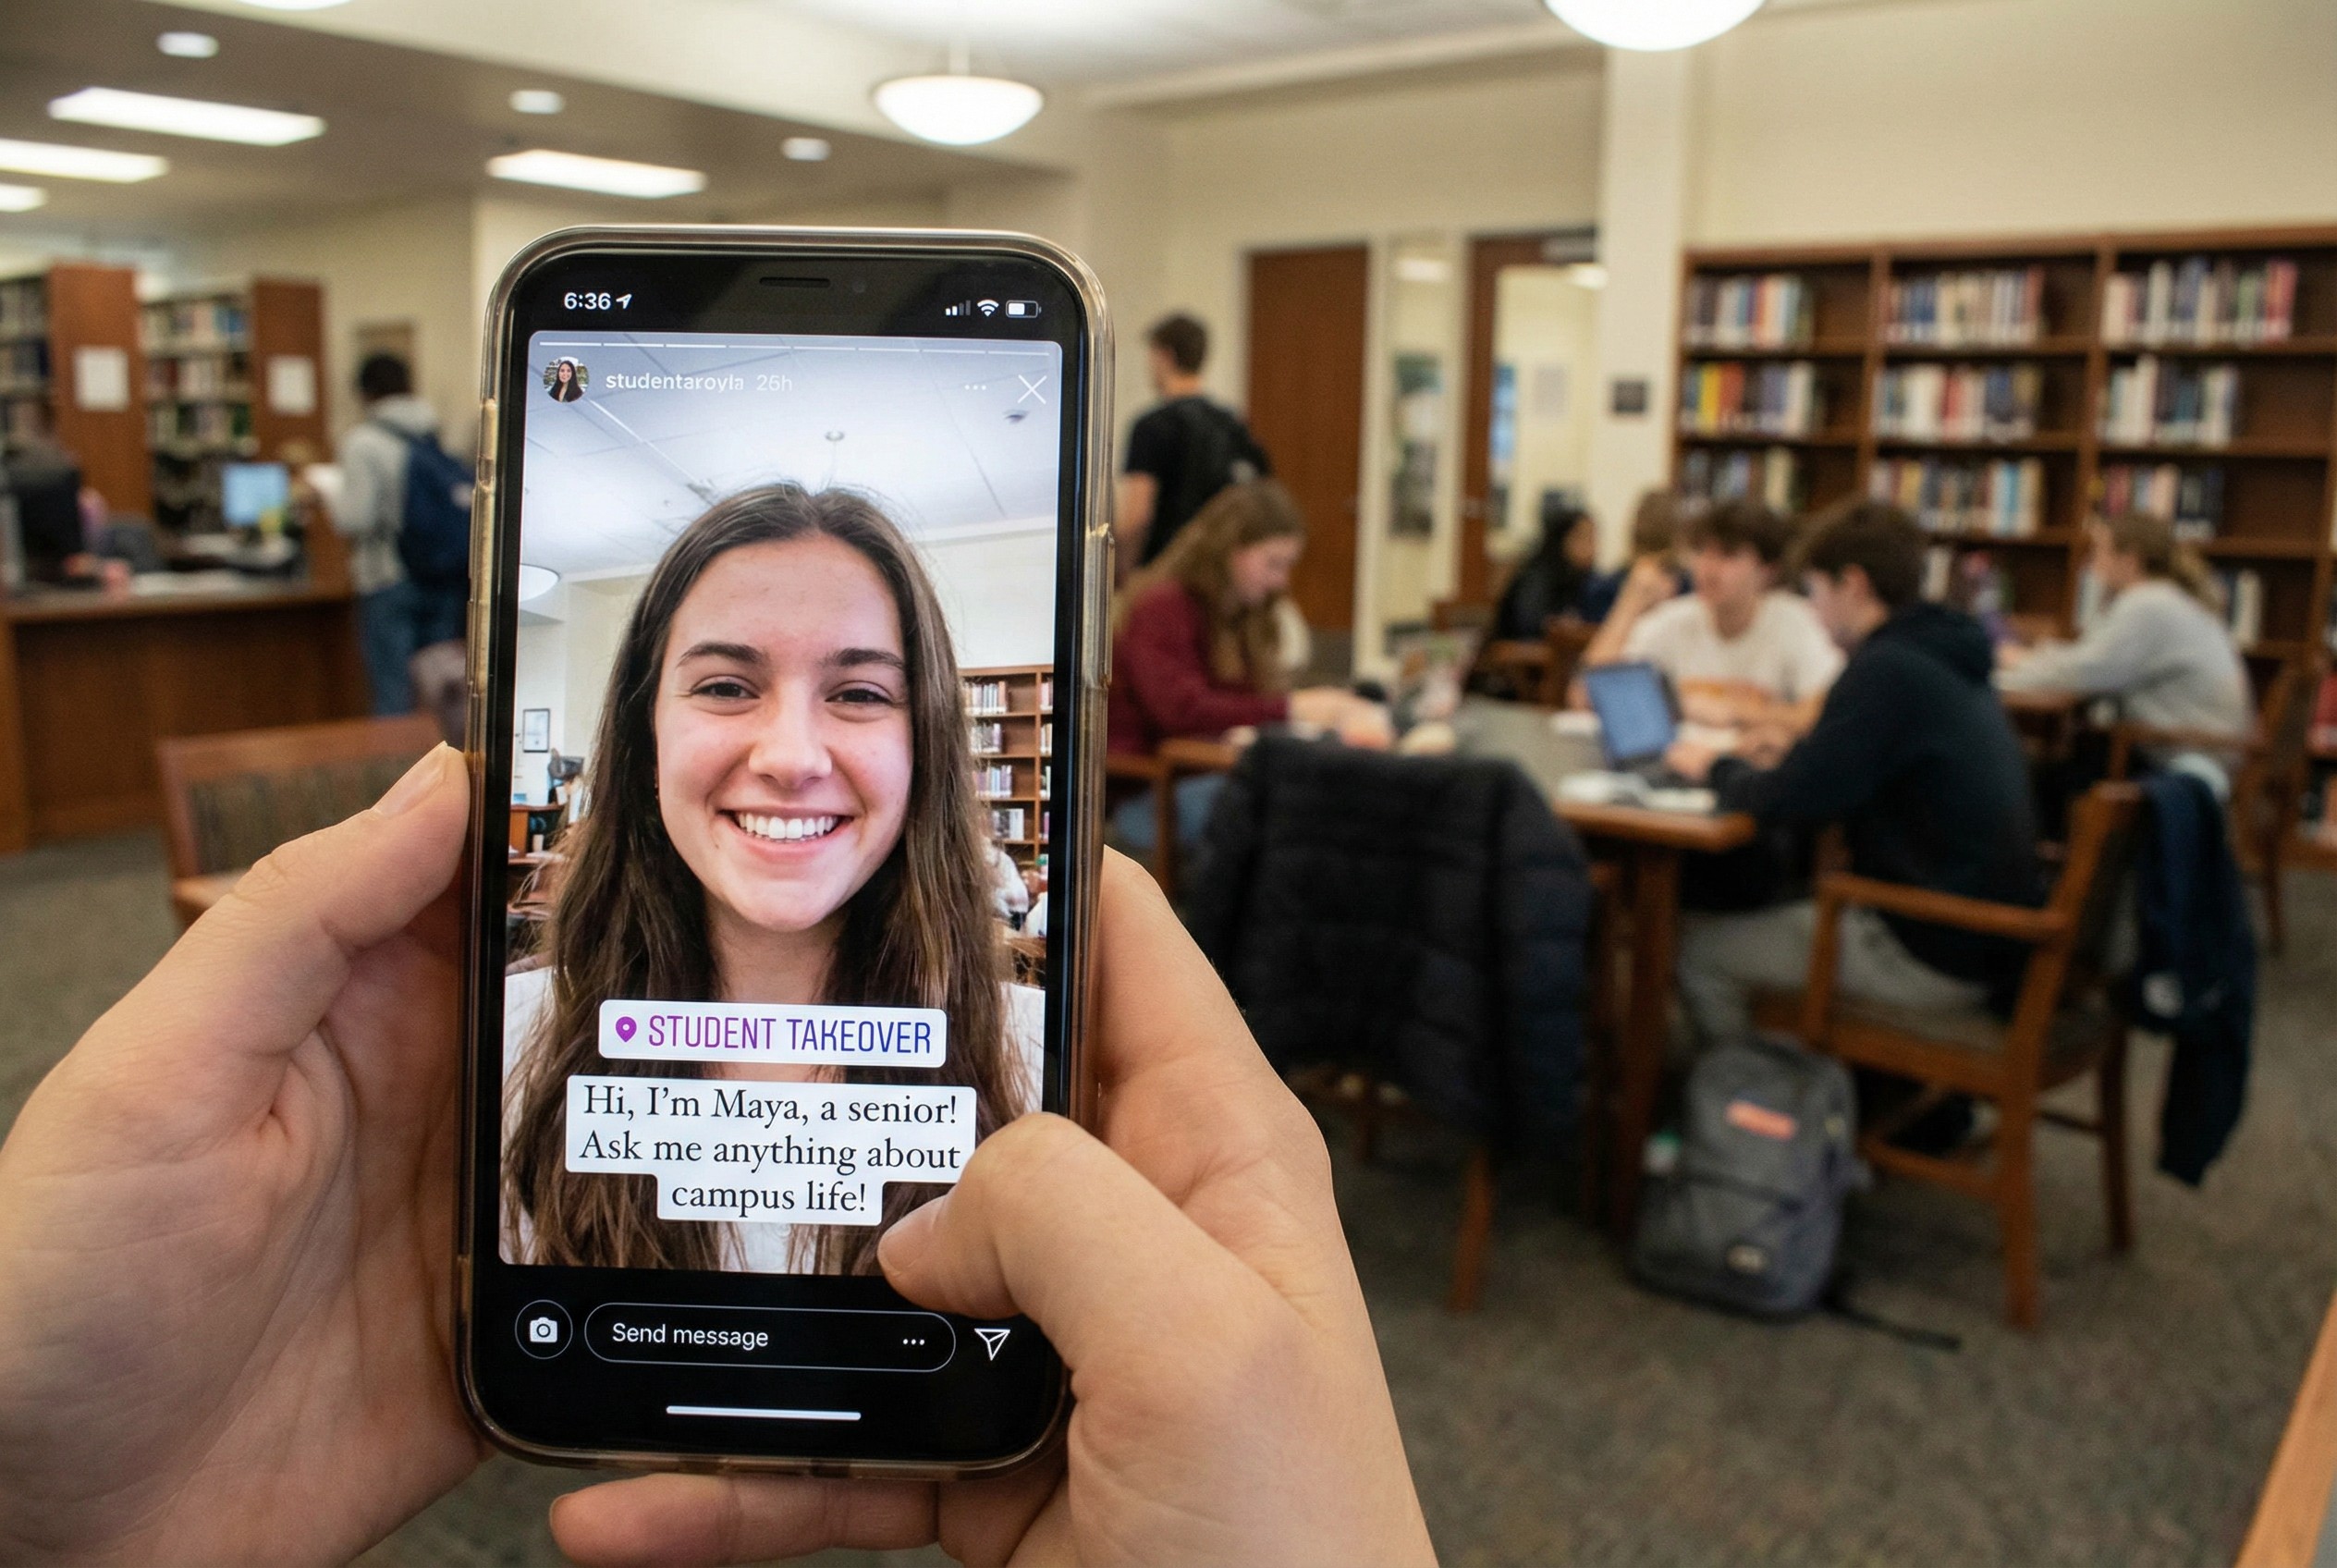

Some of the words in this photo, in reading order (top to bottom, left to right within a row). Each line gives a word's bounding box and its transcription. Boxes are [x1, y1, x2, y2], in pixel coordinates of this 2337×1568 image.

[563, 292, 612, 310] 6:36
[756, 375, 793, 392] 26h
[648, 1015, 777, 1050] STUDENT
[786, 1019, 932, 1054] TAKEOVER
[583, 1084, 635, 1121] Hi,
[646, 1085, 701, 1118] I'm
[711, 1088, 809, 1129] Maya,
[821, 1100, 838, 1121] a
[848, 1095, 956, 1124] senior!
[579, 1130, 642, 1160] Ask
[653, 1140, 703, 1161] me
[713, 1135, 857, 1176] anything
[867, 1137, 960, 1169] about
[671, 1184, 795, 1218] campus
[806, 1181, 866, 1211] life!
[612, 1322, 666, 1343] Send
[673, 1328, 769, 1351] message
